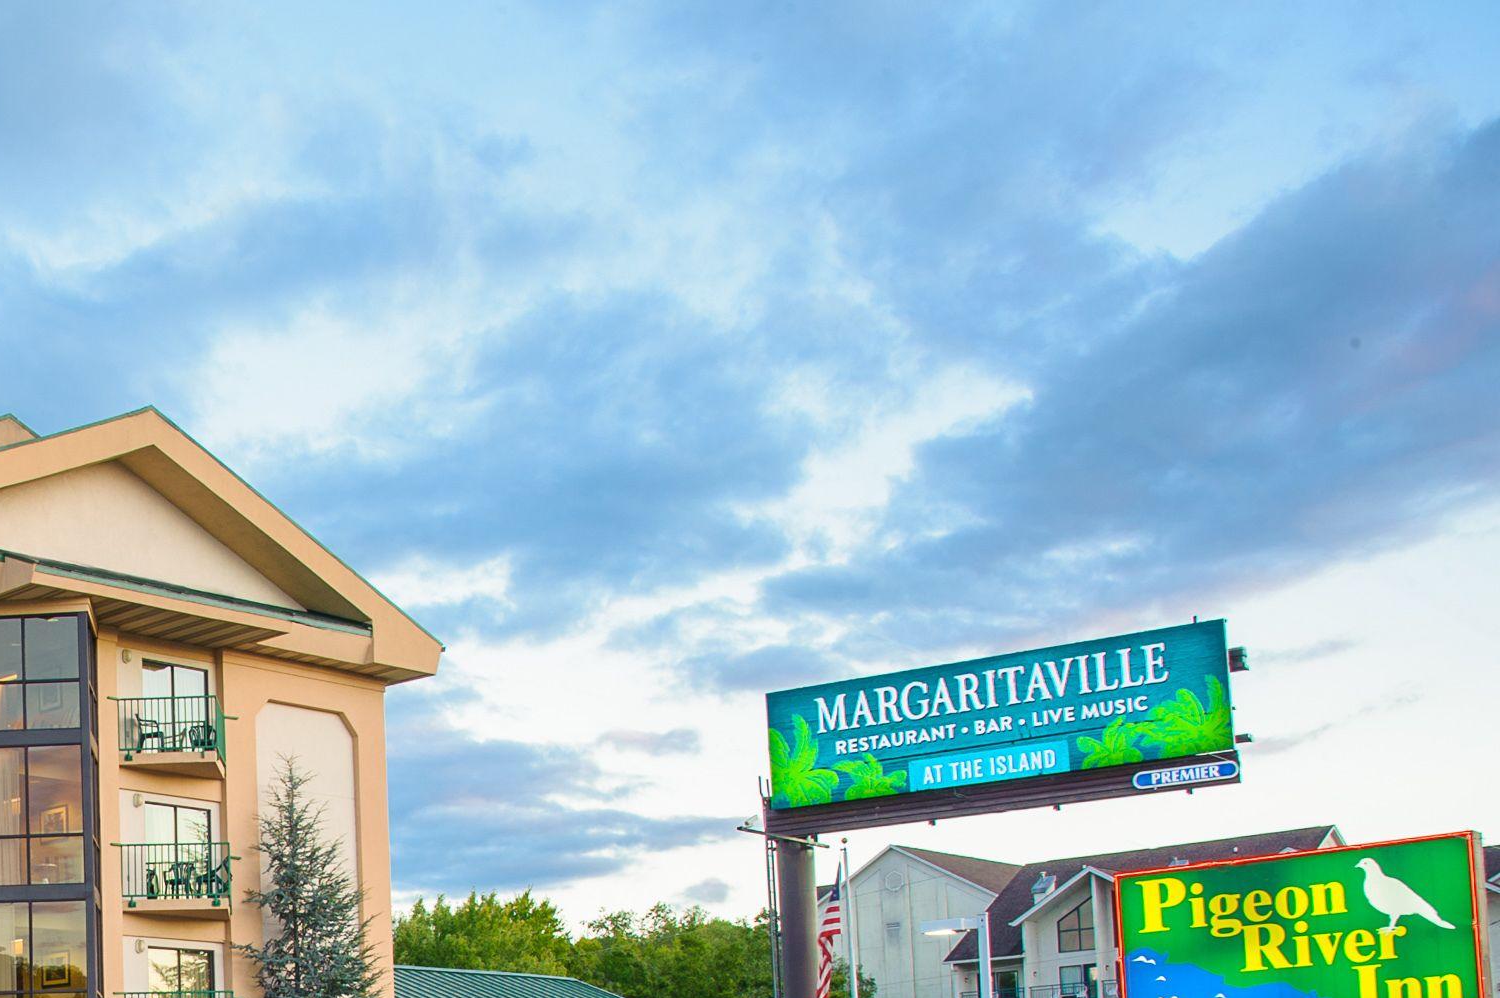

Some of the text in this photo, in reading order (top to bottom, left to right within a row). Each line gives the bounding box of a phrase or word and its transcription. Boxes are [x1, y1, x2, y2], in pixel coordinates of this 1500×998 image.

[814, 642, 1170, 735] MARGARITAVILLE
[836, 695, 1149, 755] RESTAURANT BAR LIVE MUSIC
[923, 749, 1057, 786] AT THE ISLAND
[1150, 765, 1221, 785] PREMIER
[1135, 877, 1348, 938] Pigeon
[1240, 921, 1407, 973] River
